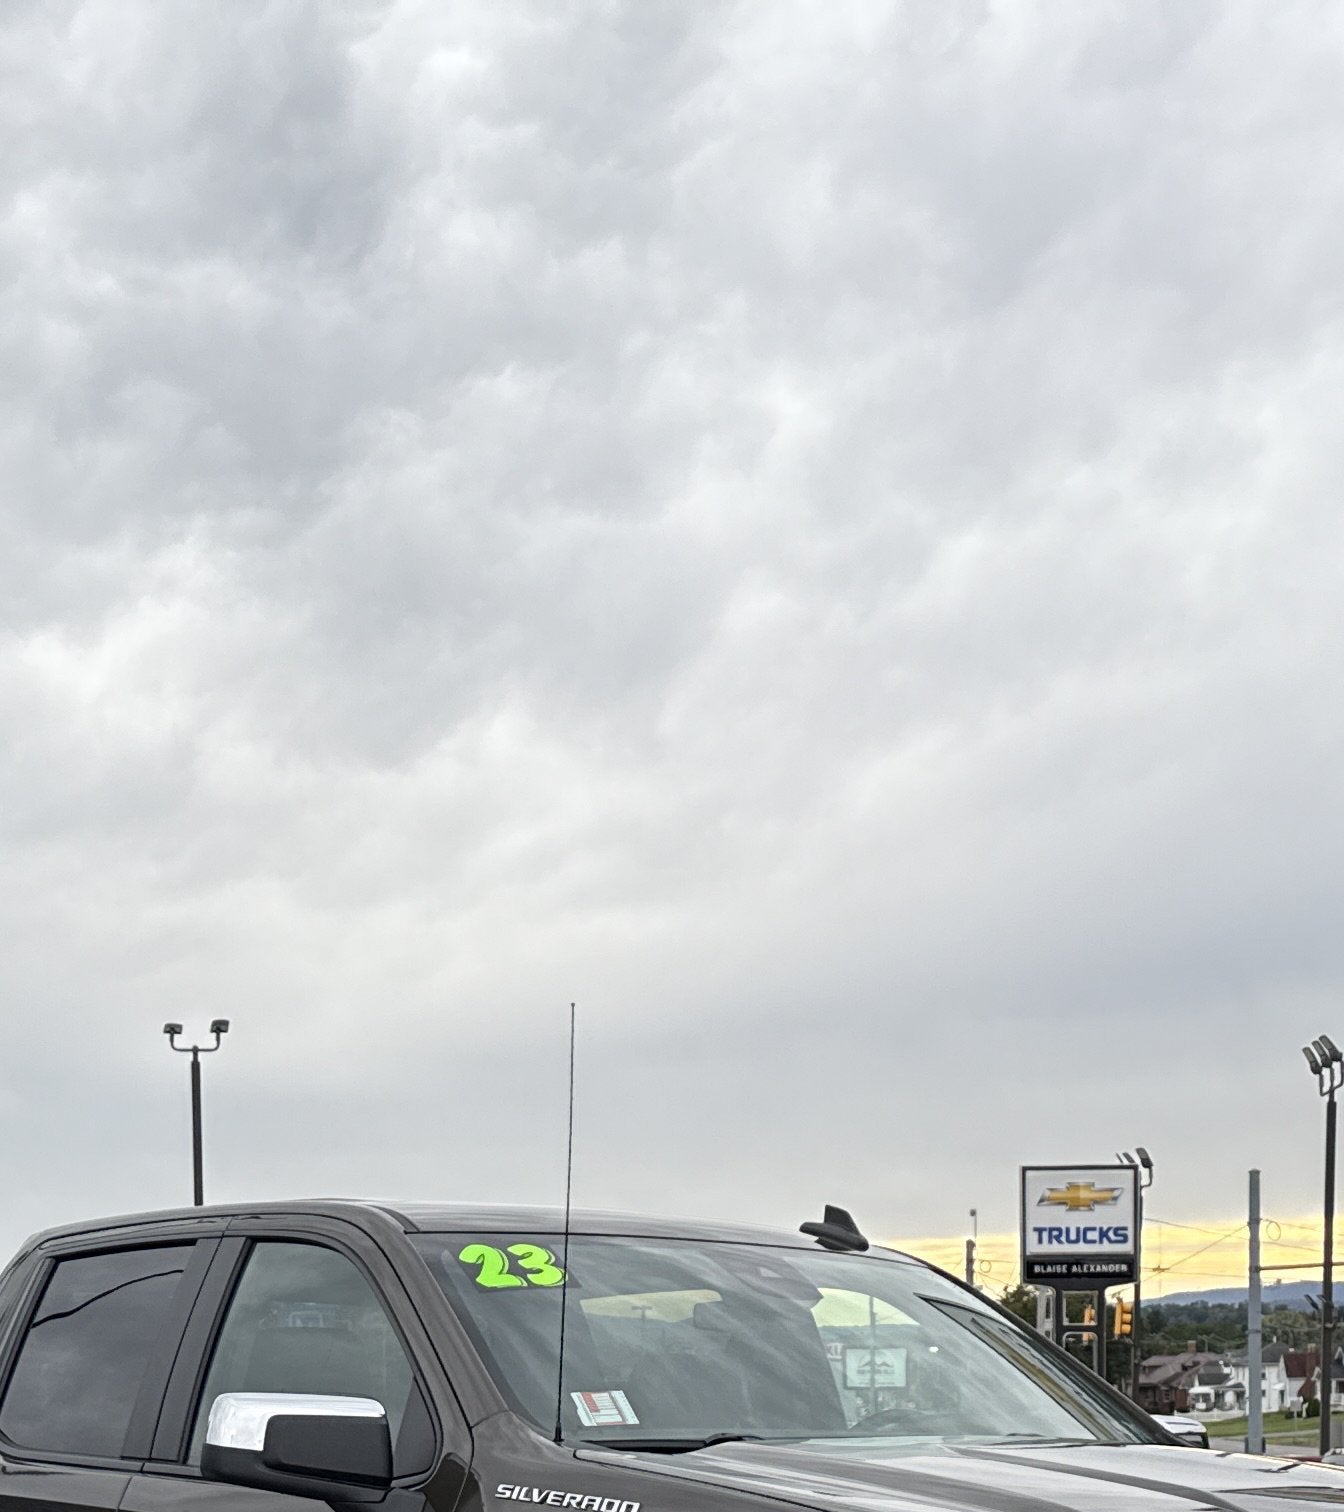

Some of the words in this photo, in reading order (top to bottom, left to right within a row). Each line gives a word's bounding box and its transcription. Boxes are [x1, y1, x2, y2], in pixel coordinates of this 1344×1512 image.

[1032, 1226, 1130, 1245] TRUCKS
[458, 1243, 569, 1288] 23
[1033, 1264, 1068, 1274] BLAISE
[1071, 1263, 1128, 1273] ALEXANDER
